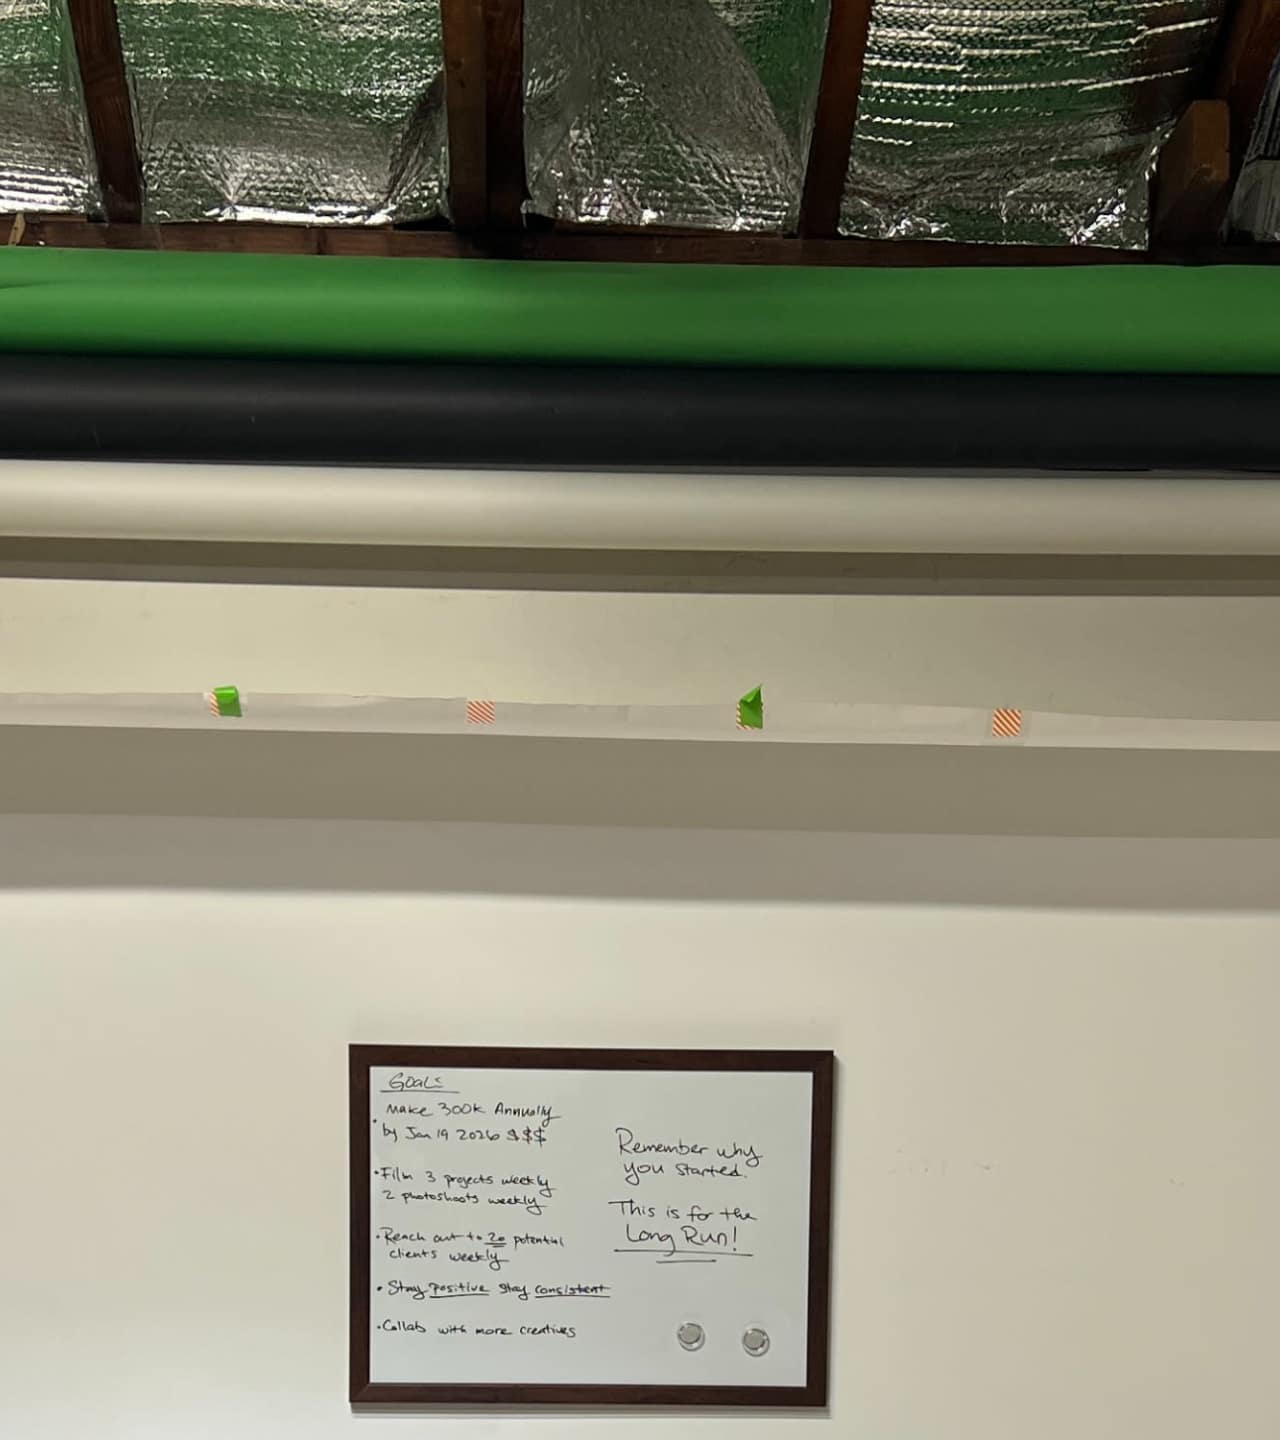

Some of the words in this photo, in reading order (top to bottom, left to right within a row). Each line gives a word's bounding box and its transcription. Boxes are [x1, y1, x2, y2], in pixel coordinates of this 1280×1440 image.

[494, 1101, 562, 1128] Annually
[382, 1122, 398, 1143] by
[405, 1126, 432, 1140] Jan
[437, 1129, 449, 1141] 19
[456, 1128, 500, 1141] 2026
[615, 1127, 709, 1156] Remember
[716, 1142, 763, 1168] why
[380, 1167, 414, 1182] Film
[424, 1170, 437, 1183] 3
[443, 1174, 494, 1190] projects
[501, 1174, 558, 1199] weekly
[623, 1161, 665, 1186] you
[381, 1189, 396, 1200] 2
[400, 1191, 480, 1205] photoshoots
[487, 1195, 548, 1216] weekly
[607, 1199, 656, 1218] This
[666, 1205, 681, 1220] is
[686, 1205, 714, 1222] for
[719, 1207, 758, 1221] the
[513, 1233, 566, 1251] potential
[626, 1224, 677, 1257] Long
[680, 1226, 738, 1252] Run!
[448, 1249, 511, 1271] weekly
[438, 1324, 467, 1336] with
[475, 1327, 513, 1336] more
[519, 1324, 577, 1339] creatives
